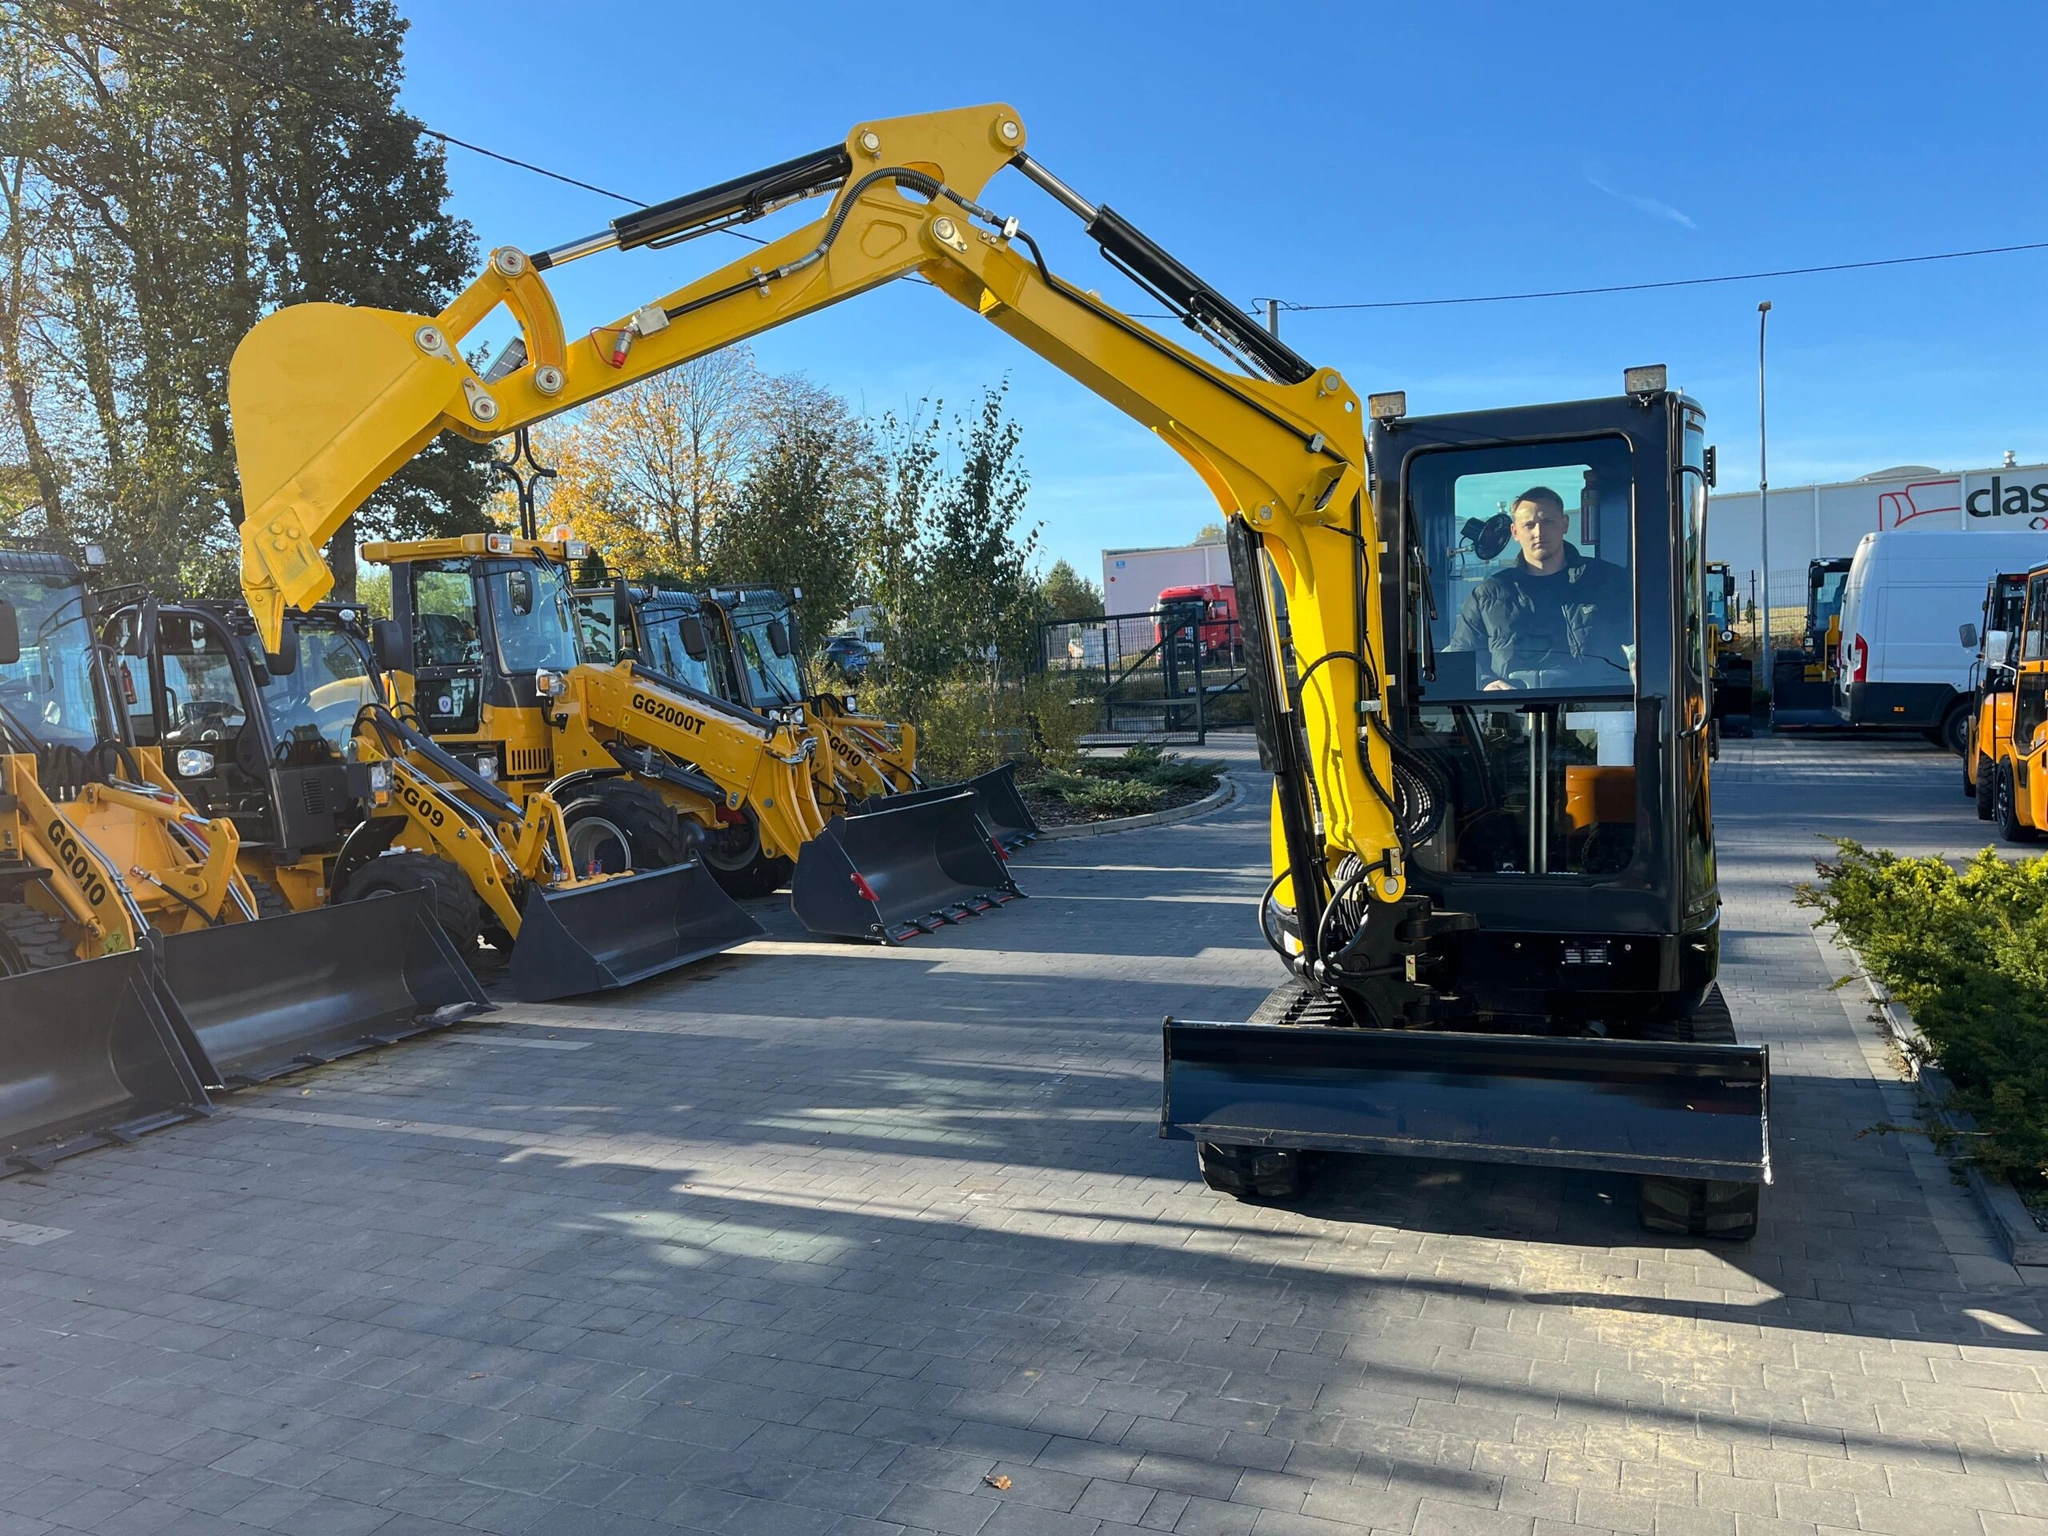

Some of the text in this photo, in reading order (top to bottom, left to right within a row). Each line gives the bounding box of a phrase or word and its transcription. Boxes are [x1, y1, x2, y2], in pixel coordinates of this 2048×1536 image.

[1966, 476, 2048, 517] clas
[632, 693, 706, 735] GG2000T
[827, 730, 862, 767] G010
[393, 774, 445, 828] GG09
[48, 819, 106, 906] GG010
